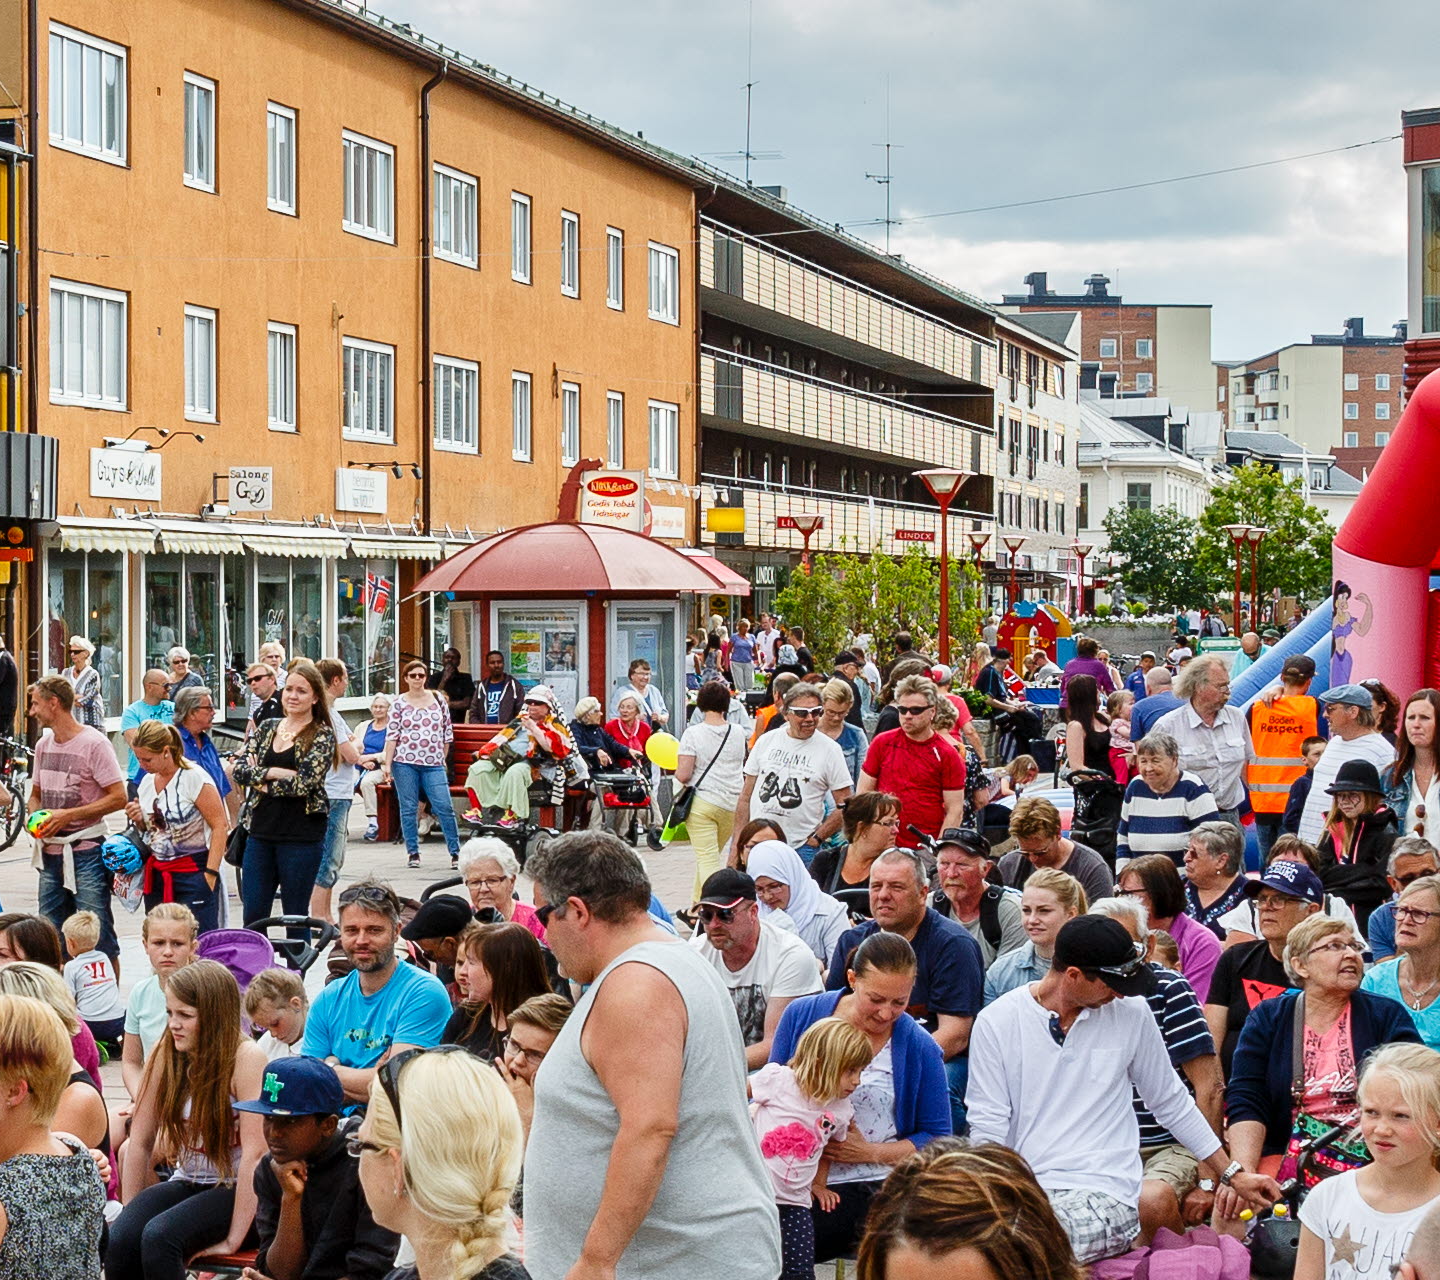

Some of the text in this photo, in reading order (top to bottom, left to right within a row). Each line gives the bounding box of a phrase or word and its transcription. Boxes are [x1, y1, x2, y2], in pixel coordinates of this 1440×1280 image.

[97, 459, 124, 488] Guys
[230, 470, 269, 482] Salong
[1268, 715, 1295, 725] Boden
[1260, 723, 1304, 735] Respect
[768, 748, 812, 767] ORIGINAL
